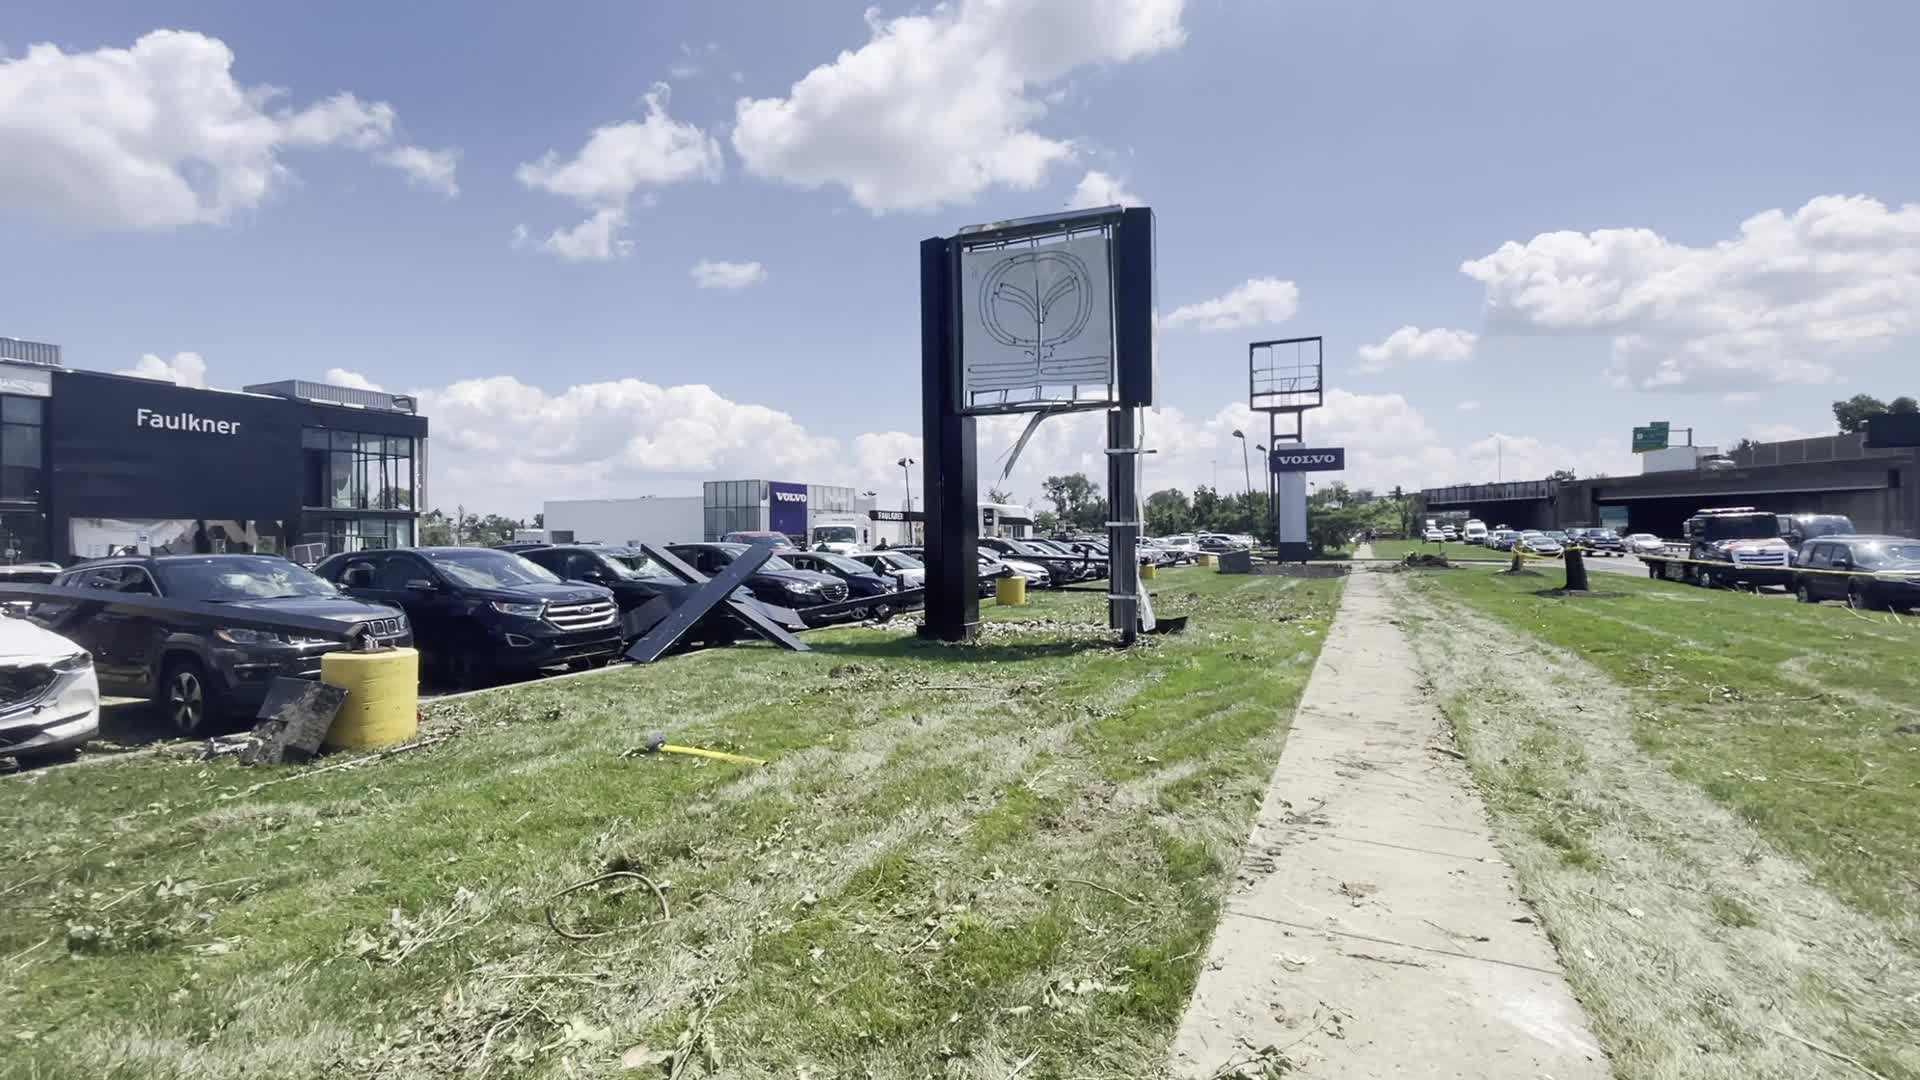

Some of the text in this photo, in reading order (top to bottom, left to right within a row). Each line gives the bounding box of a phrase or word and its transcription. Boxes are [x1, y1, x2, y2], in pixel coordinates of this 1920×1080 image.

[137, 408, 241, 435] Faulkner
[1277, 454, 1336, 465] VOLVO
[776, 492, 807, 502] VOLVO
